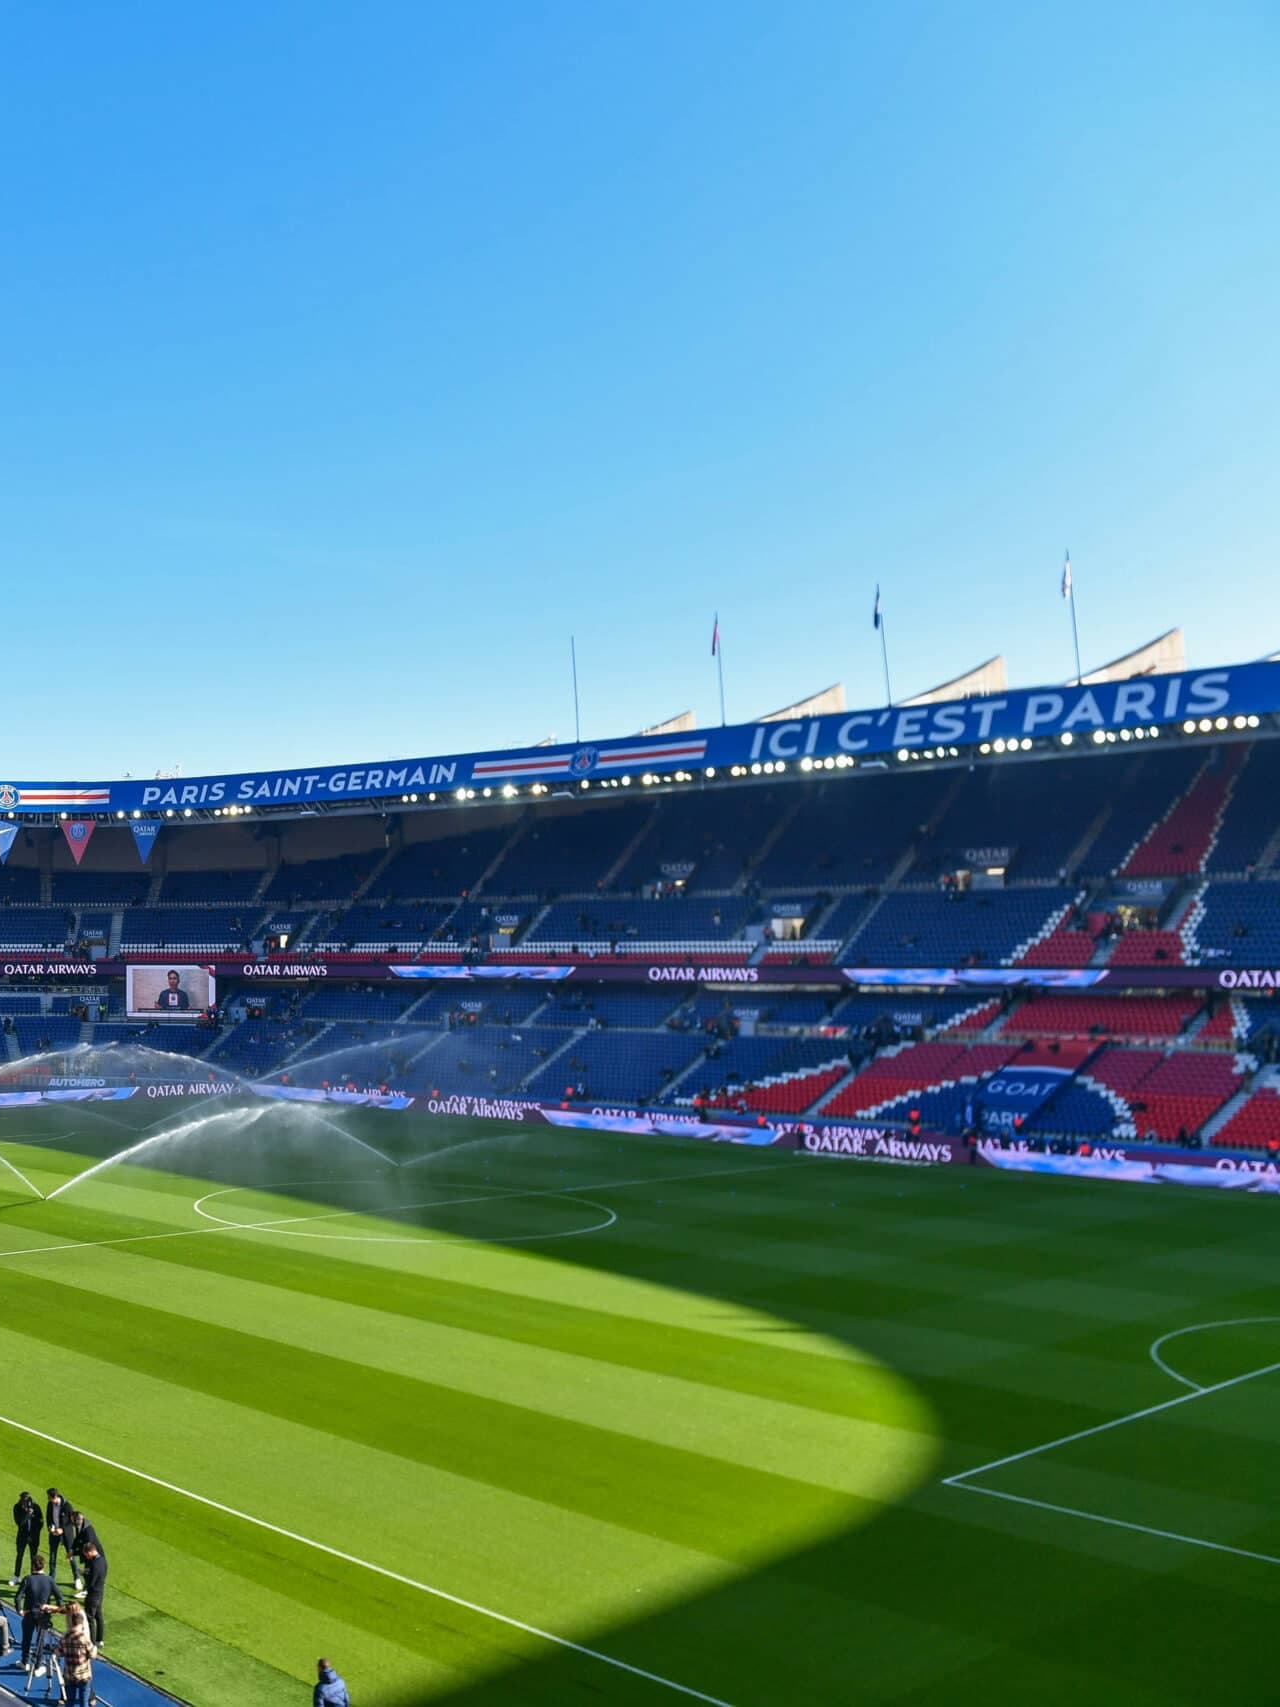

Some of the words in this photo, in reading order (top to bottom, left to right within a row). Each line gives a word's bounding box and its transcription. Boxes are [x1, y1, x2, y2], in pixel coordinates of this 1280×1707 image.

[749, 722, 821, 760] ICI
[1022, 671, 1232, 733] PARIS
[141, 782, 226, 806] PARIS
[237, 762, 458, 801] SAINT-GERMAIN
[966, 848, 1008, 861] QATAR
[4, 964, 44, 975] QATAR
[47, 964, 97, 975] AIRWAYS
[243, 965, 280, 976] QATAR
[283, 965, 328, 976] AIRWAYS
[648, 967, 695, 982] QATAR
[697, 967, 759, 981] AIRWAYS
[48, 1078, 106, 1088] AUTOHERO
[986, 1078, 1057, 1097] GOAT
[147, 1087, 184, 1098] QATAR
[428, 1100, 468, 1116] QATAR
[472, 1103, 524, 1121] AIRWAYS
[805, 1133, 867, 1155] QATAR
